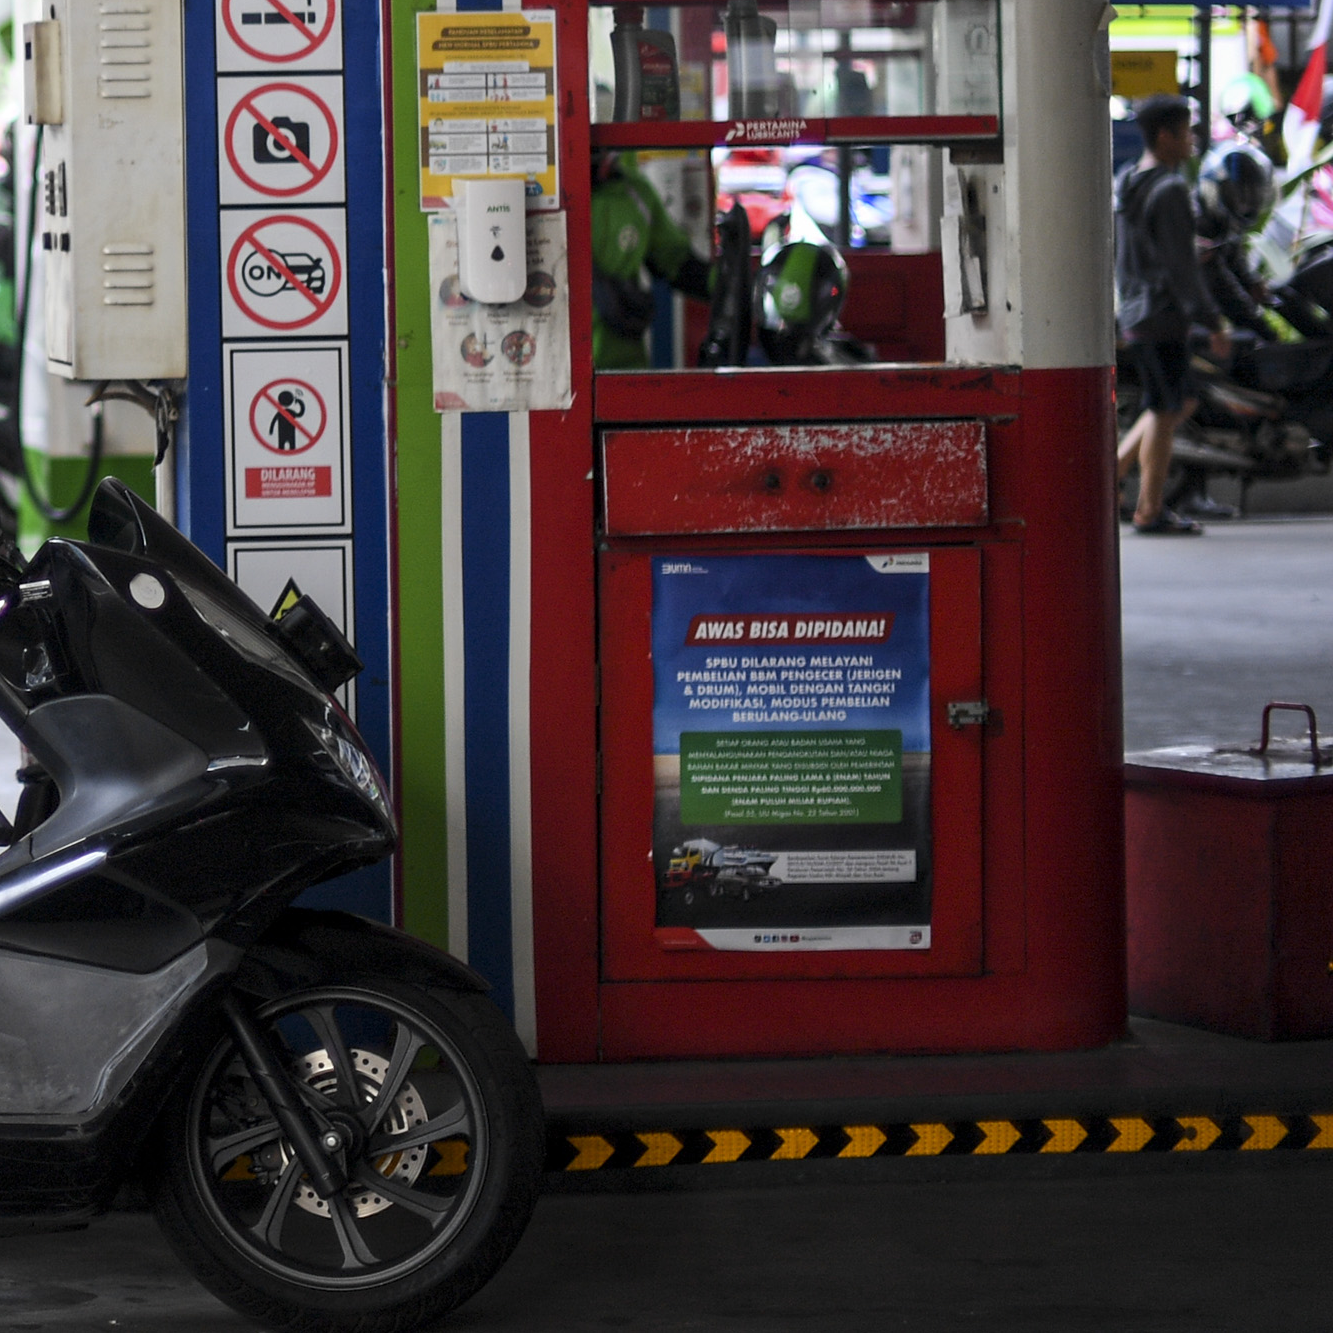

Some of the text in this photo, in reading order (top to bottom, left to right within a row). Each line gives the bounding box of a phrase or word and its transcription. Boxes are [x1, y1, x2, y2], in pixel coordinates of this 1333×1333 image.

[746, 120, 807, 131] PERTAMINA
[248, 265, 282, 280] ON
[261, 468, 315, 481] DILARANG
[694, 619, 886, 639] AWAS BISA DIPIDANA!
[705, 656, 873, 668] SPBU DILARANG MELAYANI
[677, 669, 902, 682] PEMBELIAN BBM PENGECER (JERIGEN
[747, 684, 786, 695] MOBIL
[790, 684, 844, 694] DENGAN
[848, 683, 895, 694] TANGKI
[689, 696, 890, 709] MODIFIKASI, MODUS PEMBELIAN
[733, 711, 847, 722] BERULANG-ULANG
